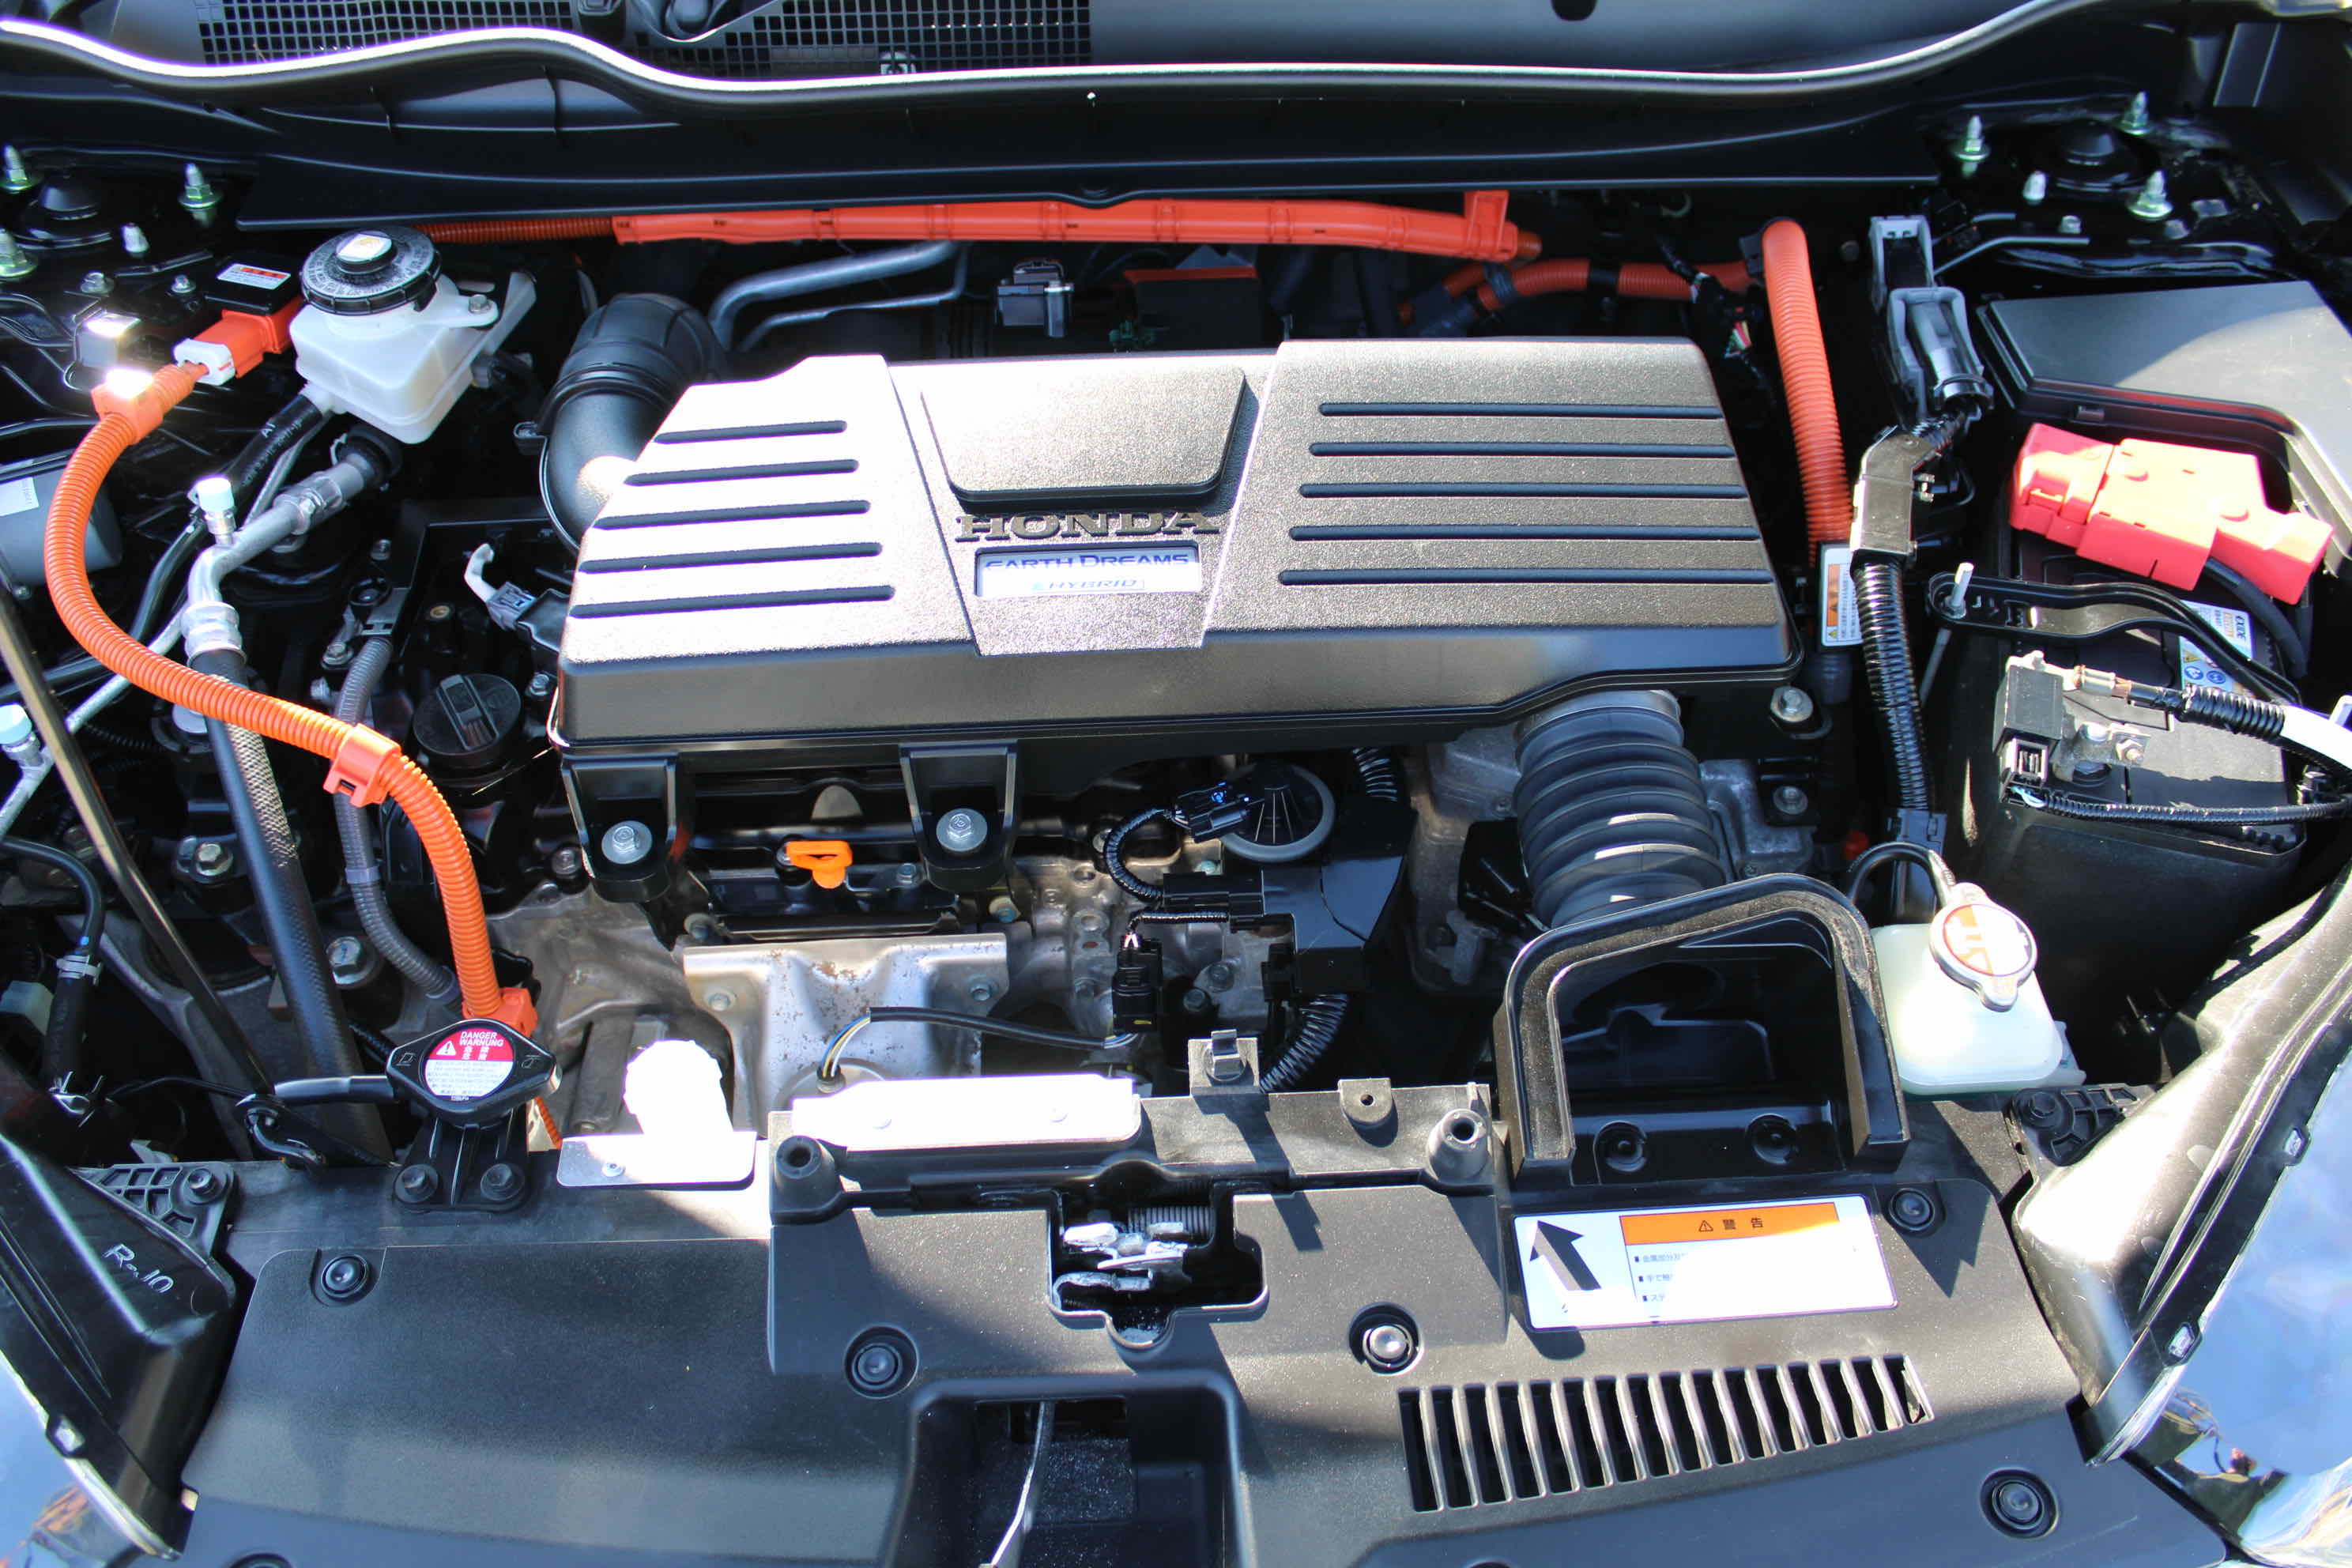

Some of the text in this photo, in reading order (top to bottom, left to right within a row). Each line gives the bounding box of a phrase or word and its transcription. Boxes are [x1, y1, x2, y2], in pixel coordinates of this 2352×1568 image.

[955, 513, 1221, 542] HONDA
[985, 556, 1073, 571] EARTH
[1048, 579, 1138, 589] HYBRID
[460, 1031, 498, 1039] DANGER
[458, 1038, 504, 1047] WARNUNG
[1722, 1216, 1764, 1231] 警告
